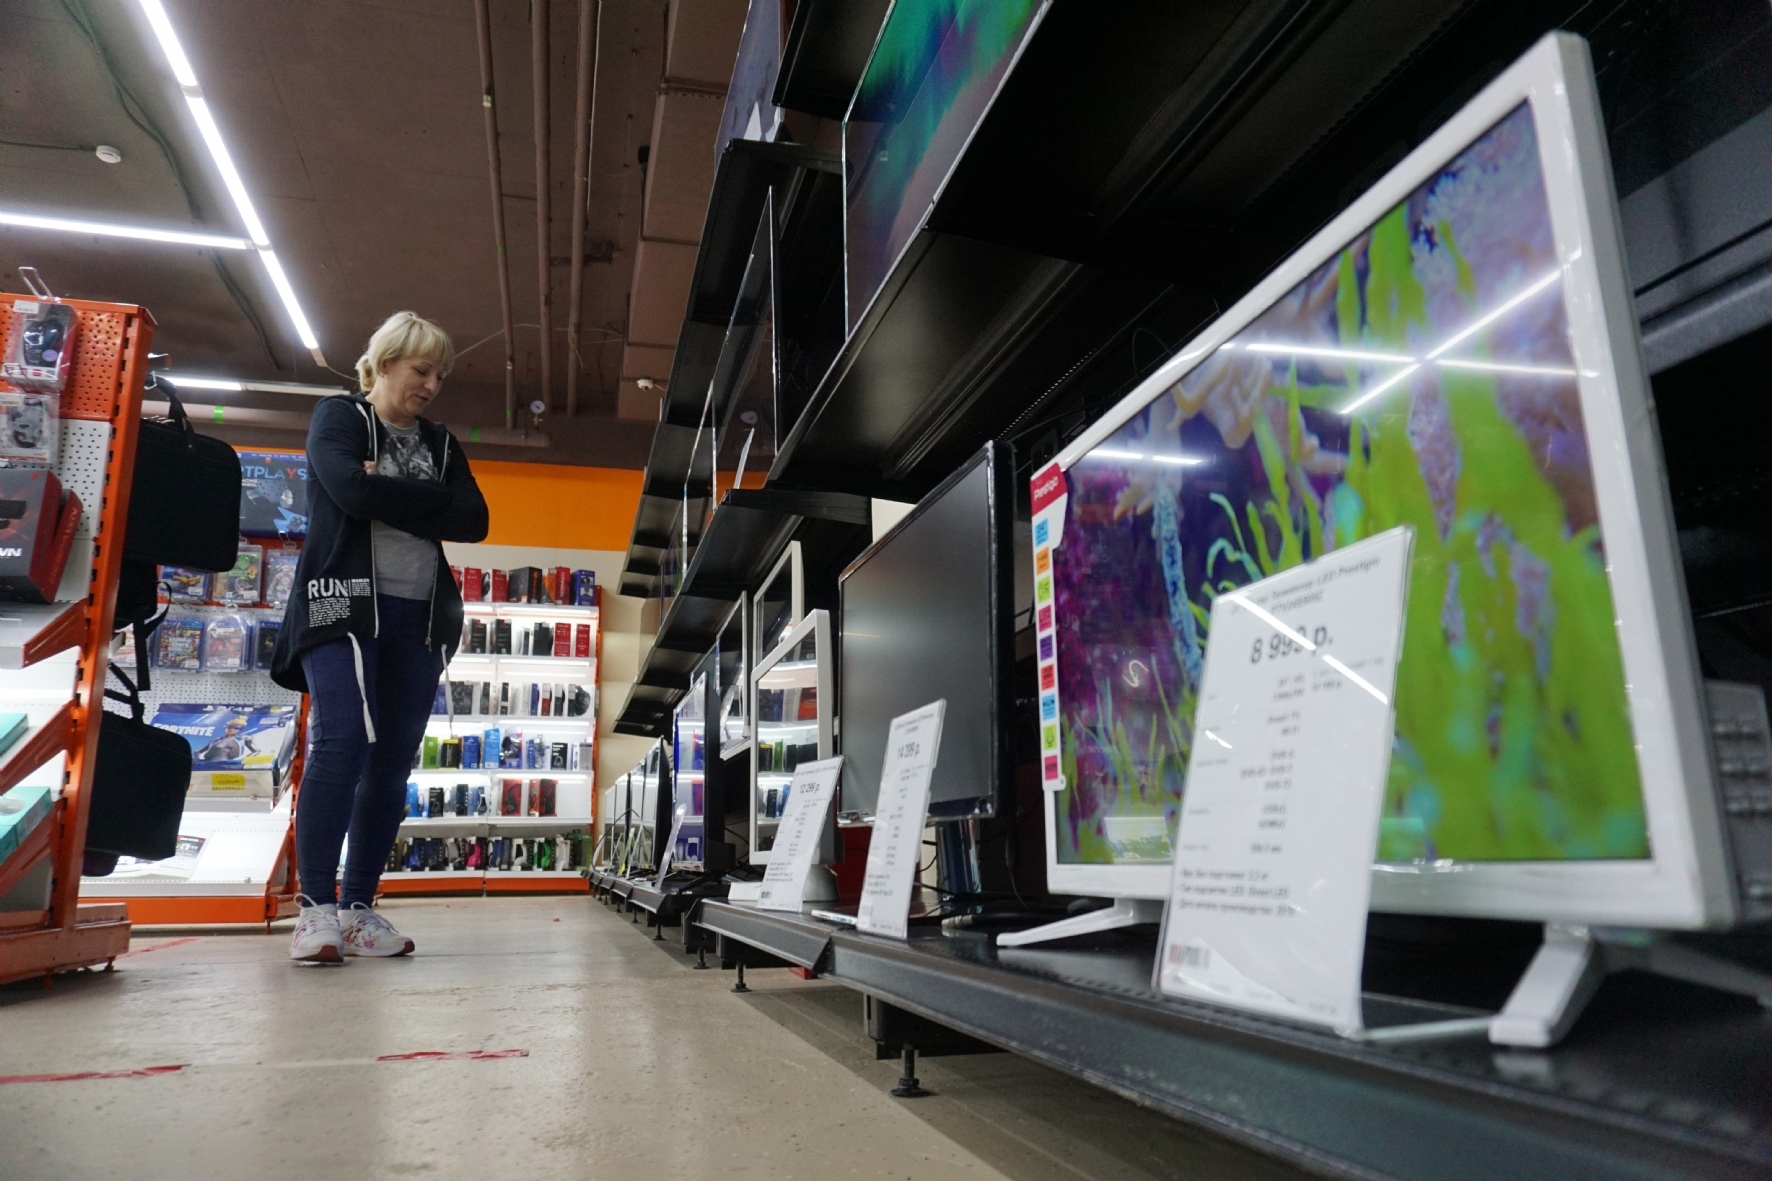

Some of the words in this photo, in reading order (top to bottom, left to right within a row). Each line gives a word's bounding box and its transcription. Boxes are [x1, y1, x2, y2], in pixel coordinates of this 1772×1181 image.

[241, 465, 308, 480] TPLAYS
[308, 577, 349, 600] RUN
[1251, 638, 1263, 664] 8
